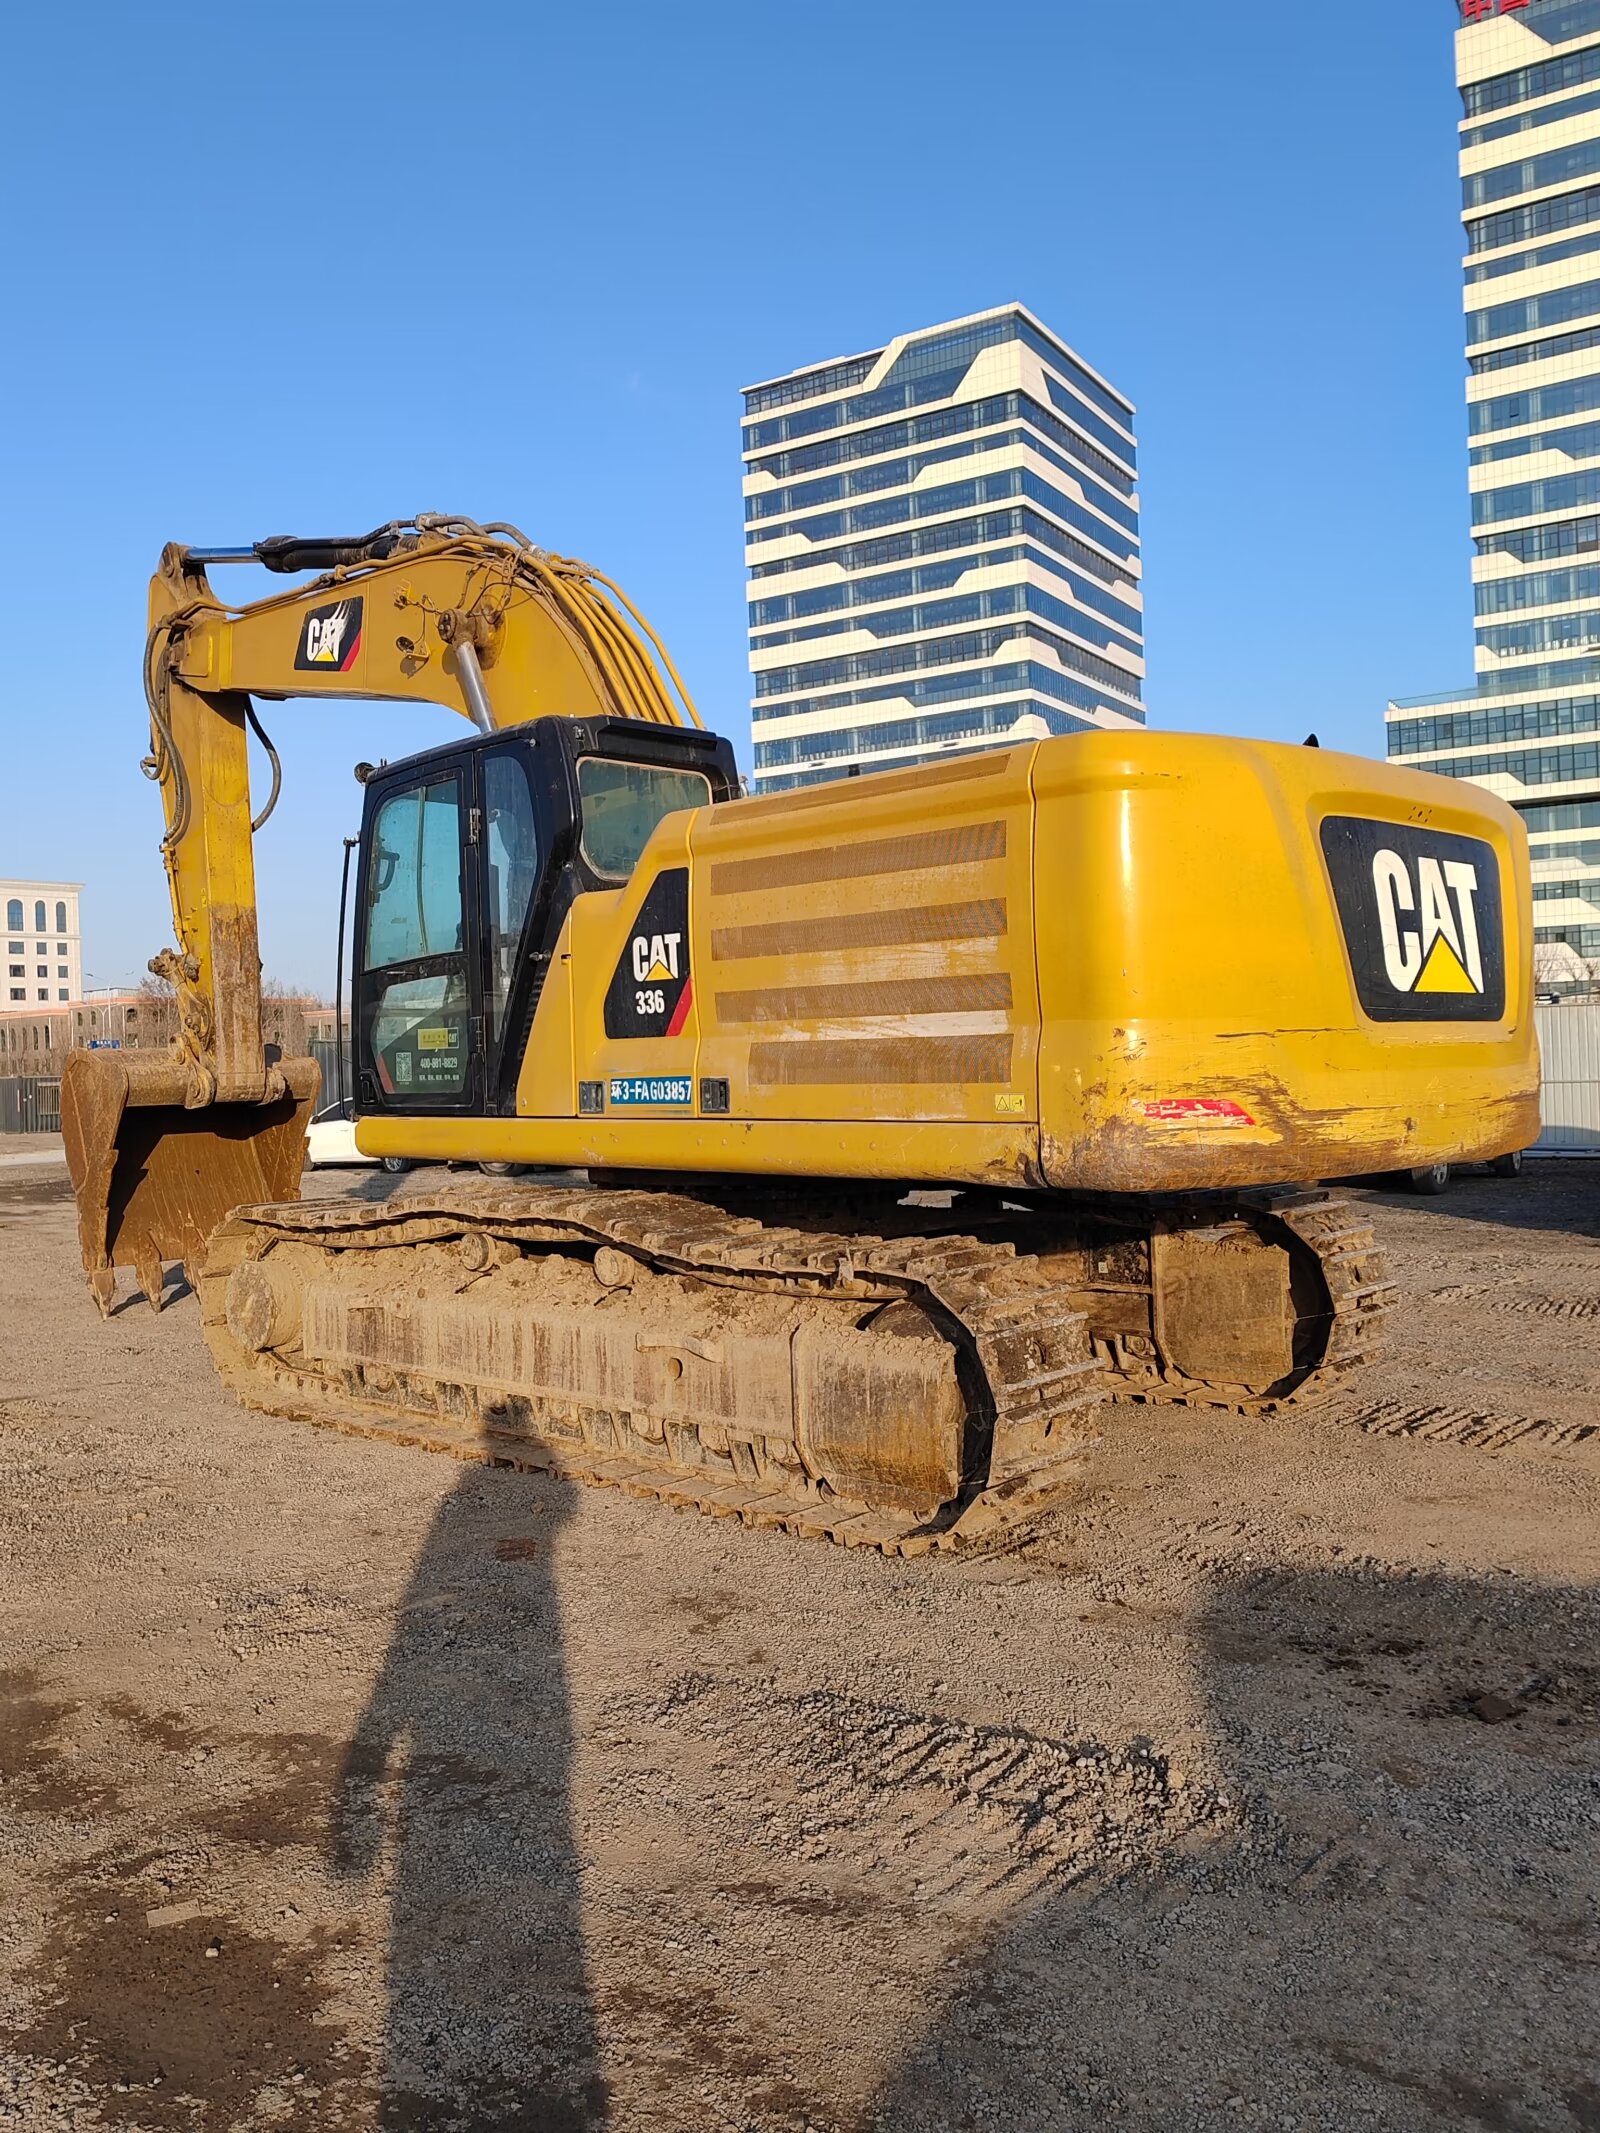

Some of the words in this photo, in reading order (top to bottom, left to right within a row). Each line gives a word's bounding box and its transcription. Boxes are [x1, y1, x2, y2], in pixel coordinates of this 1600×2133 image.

[306, 618, 346, 662] CAT
[1372, 849, 1484, 994] CAT
[632, 933, 681, 983] CAT
[635, 989, 665, 1015] 336
[611, 1080, 692, 1101] 环3-FAG03857
